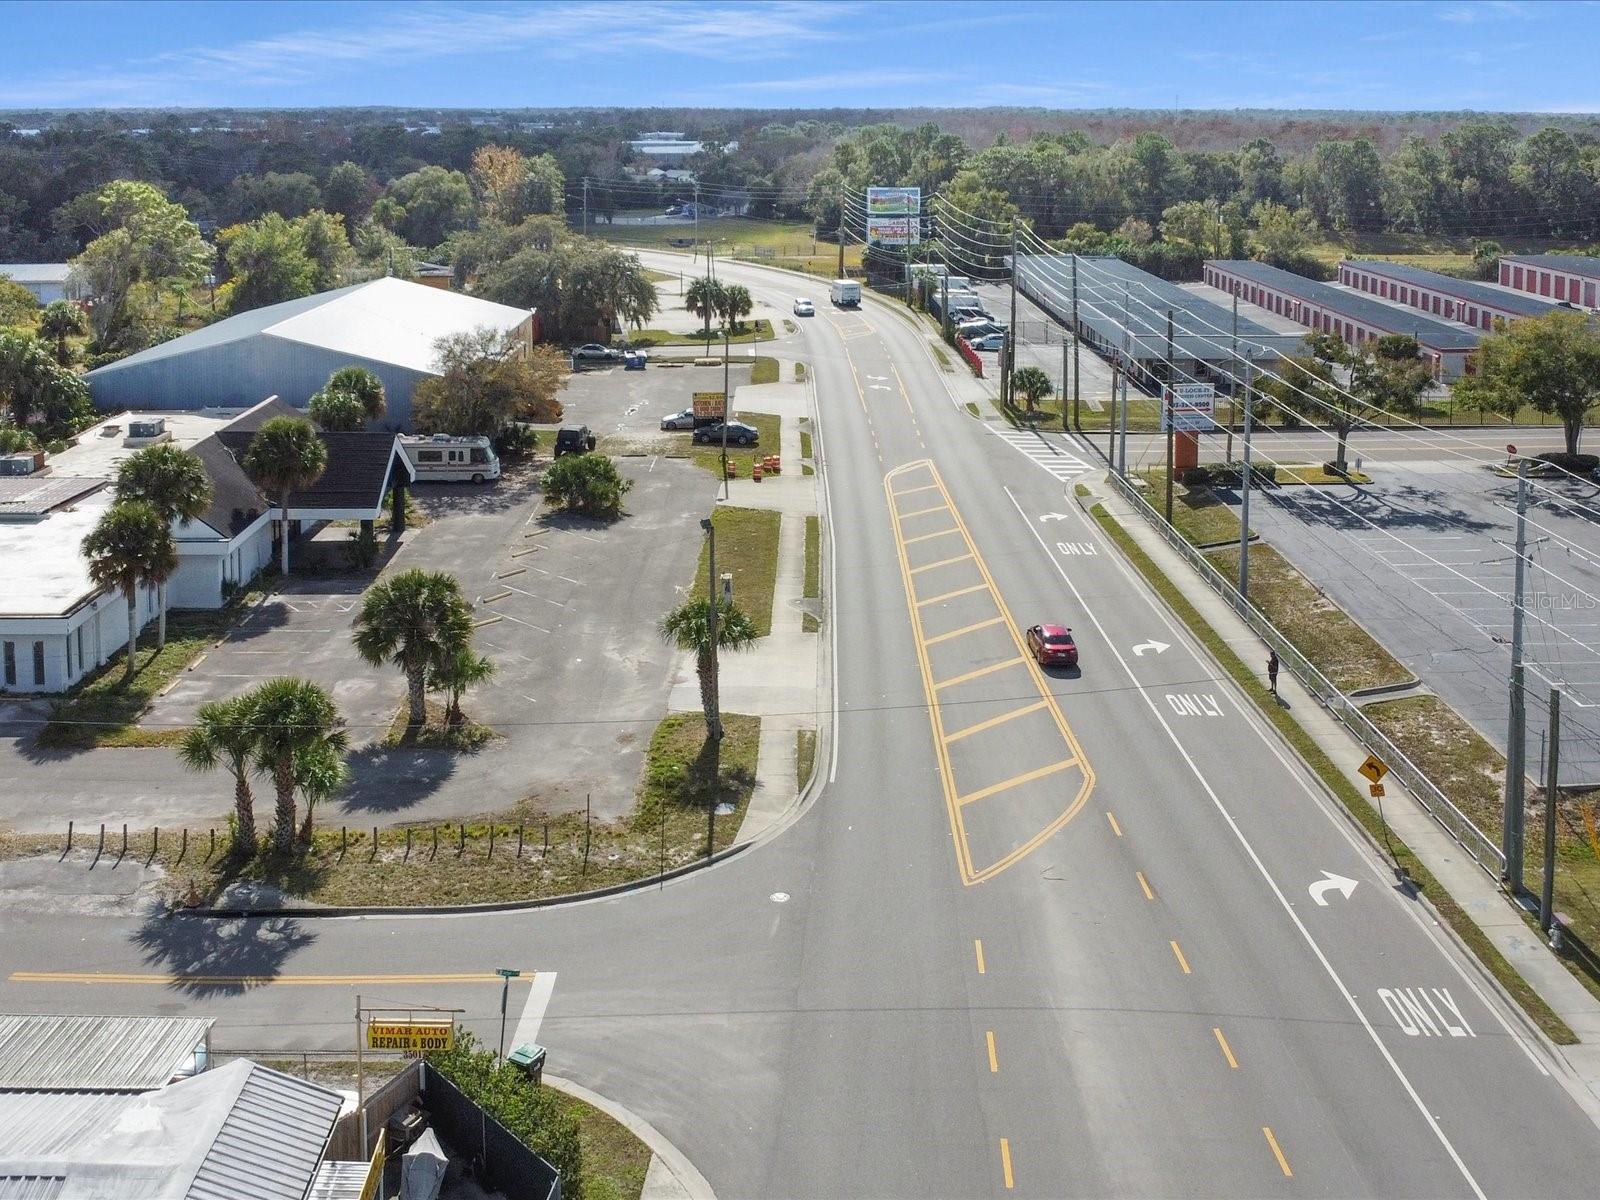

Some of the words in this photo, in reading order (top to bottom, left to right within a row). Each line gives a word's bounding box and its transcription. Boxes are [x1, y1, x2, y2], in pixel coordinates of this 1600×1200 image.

[1056, 543, 1098, 555] ONLY
[1165, 694, 1224, 717] ONLY
[1377, 987, 1476, 1037] ONLY
[372, 1027, 412, 1035] VIMAR
[416, 1027, 448, 1035] AUTO
[372, 1037, 410, 1048] REPAIR
[412, 1039, 418, 1048] &
[420, 1038, 448, 1049] BODY
